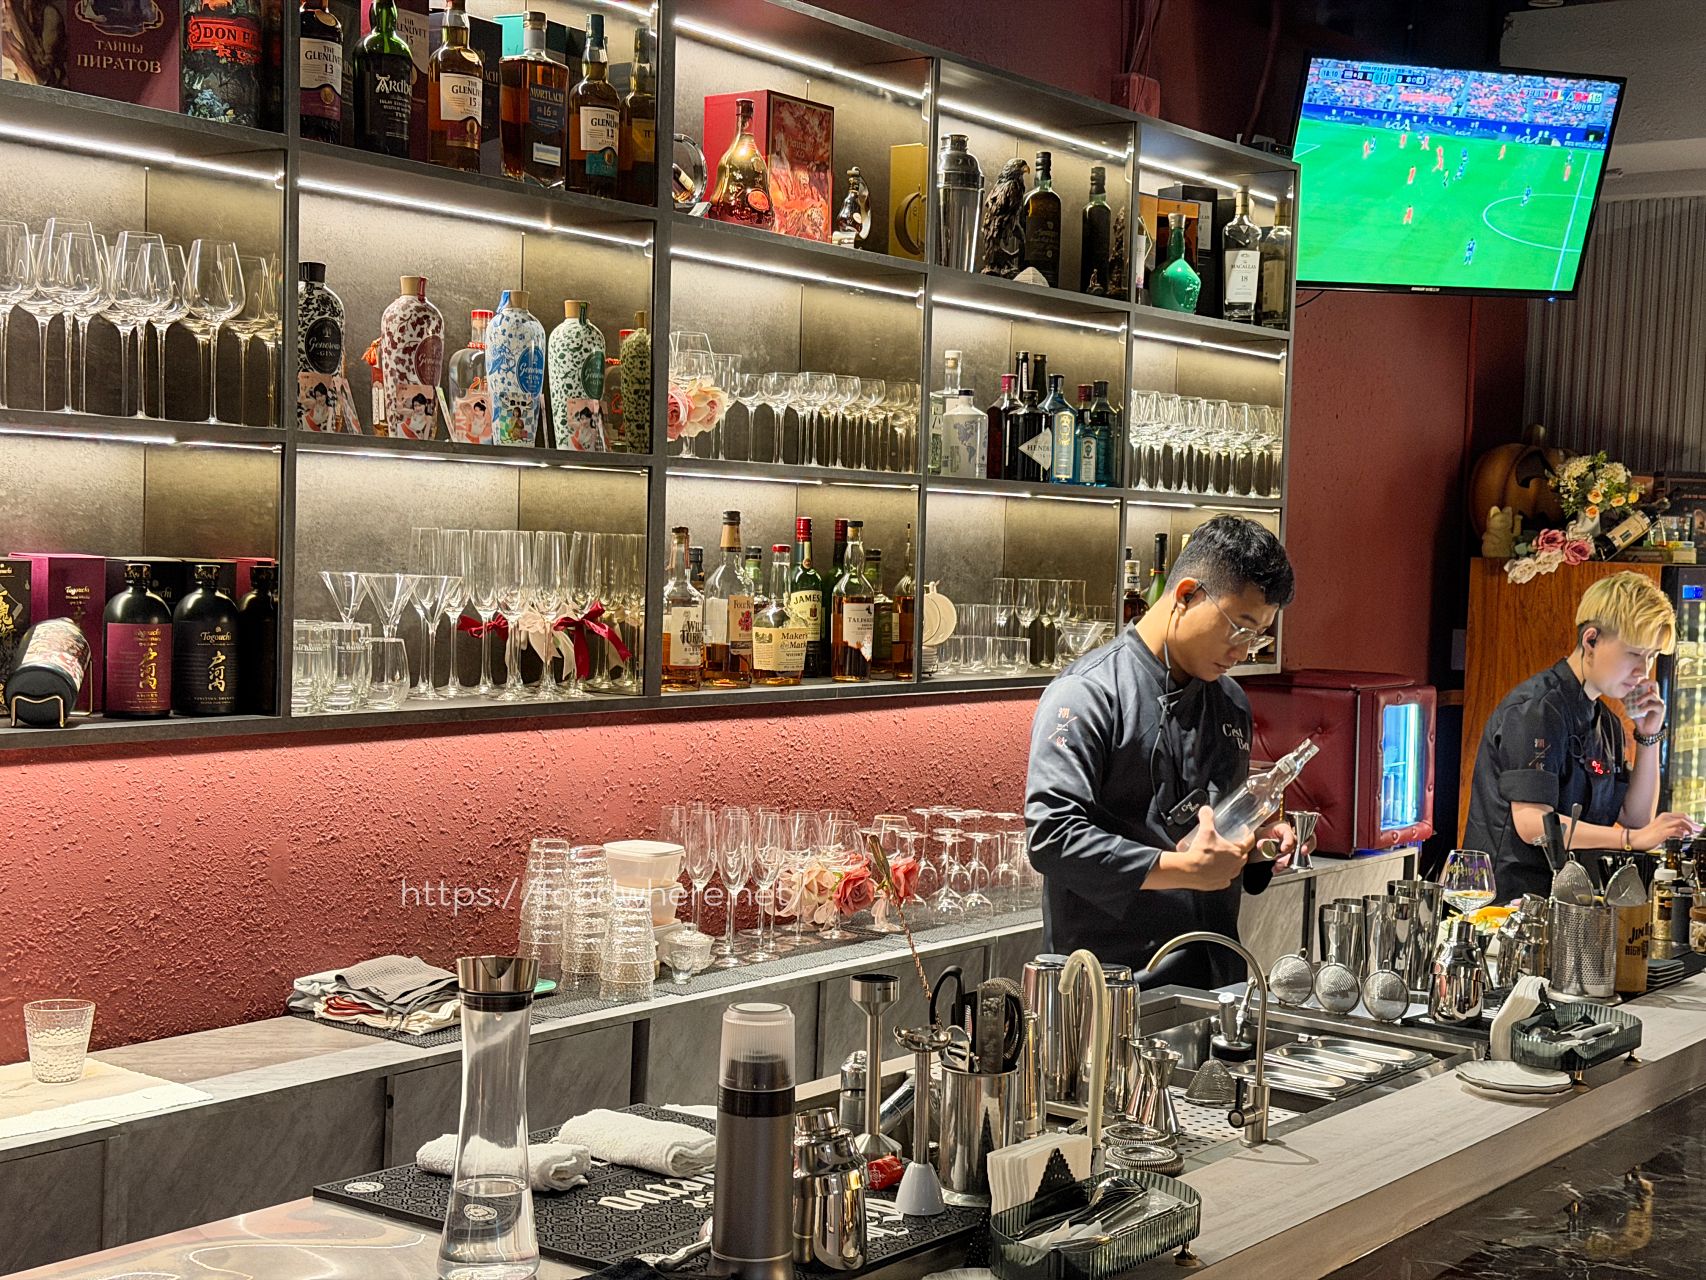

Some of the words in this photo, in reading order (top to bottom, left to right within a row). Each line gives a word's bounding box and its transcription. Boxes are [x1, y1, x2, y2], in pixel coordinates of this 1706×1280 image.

[203, 26, 237, 41] DON
[77, 54, 161, 73] ПИРАТОВ
[324, 63, 334, 74] 13
[469, 96, 477, 107] 15
[606, 128, 615, 138] 12
[200, 631, 232, 644] Togouchi
